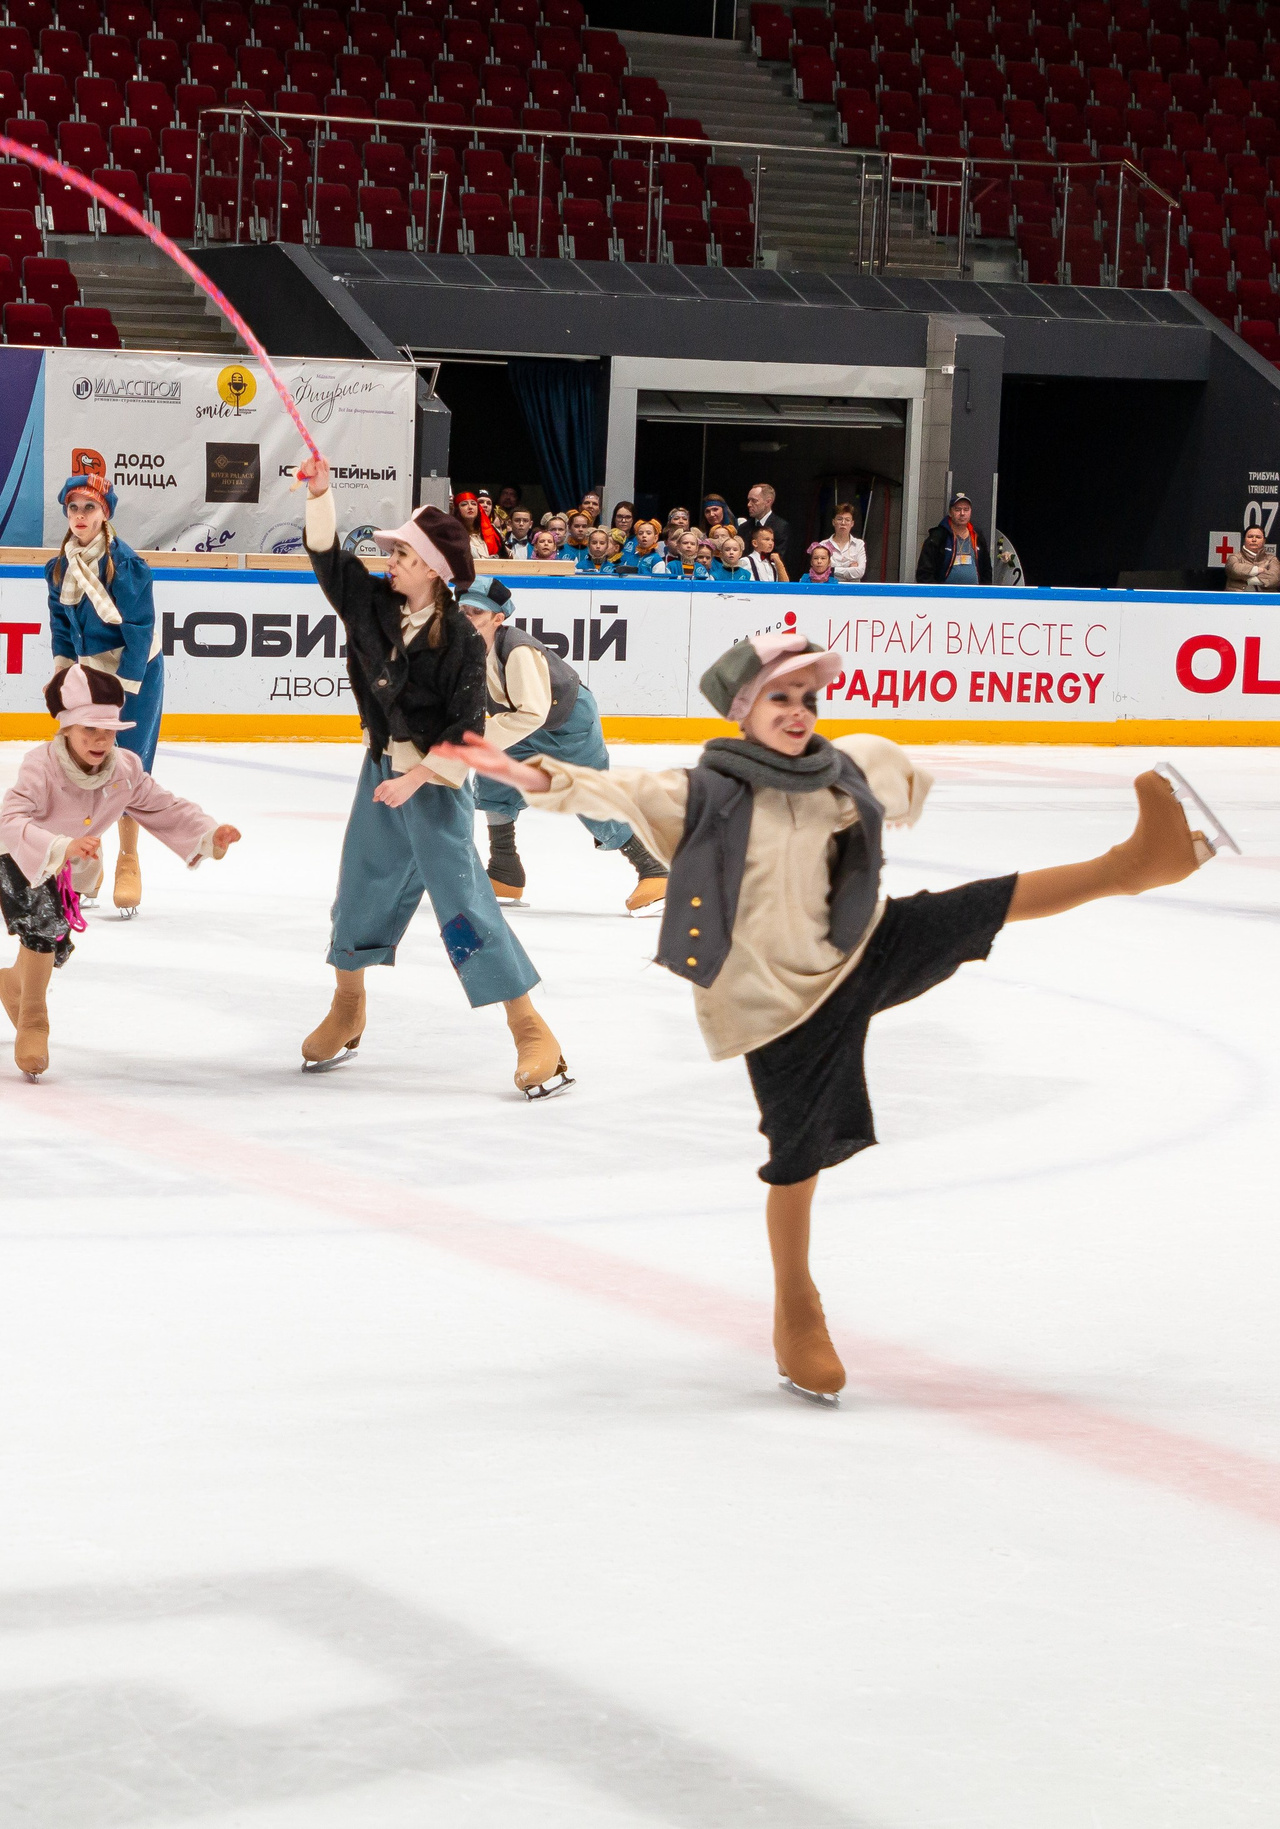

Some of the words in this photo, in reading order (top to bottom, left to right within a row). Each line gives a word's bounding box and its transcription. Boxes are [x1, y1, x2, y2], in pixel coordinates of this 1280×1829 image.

[195, 401, 232, 418] smile
[291, 376, 385, 424] Фигурист
[114, 453, 165, 470] ДОДО
[114, 473, 177, 490] ПИЦЦА
[279, 464, 397, 481] ЮЕЙНЫЙ
[1248, 471, 1280, 481] ТРИБУНА
[1244, 501, 1279, 539] 07
[360, 545, 376, 553] Стоп
[162, 605, 628, 662] ЮБИЫЙ
[827, 613, 932, 653] ИГРАЙ
[946, 621, 1074, 656] ВМЕСТЕ
[1085, 624, 1108, 657] С
[1176, 634, 1280, 695] OL
[270, 677, 352, 701] ДВОР
[826, 669, 958, 708] РАДИО
[969, 670, 1106, 704] ENERGY
[1112, 691, 1128, 703] 16+
